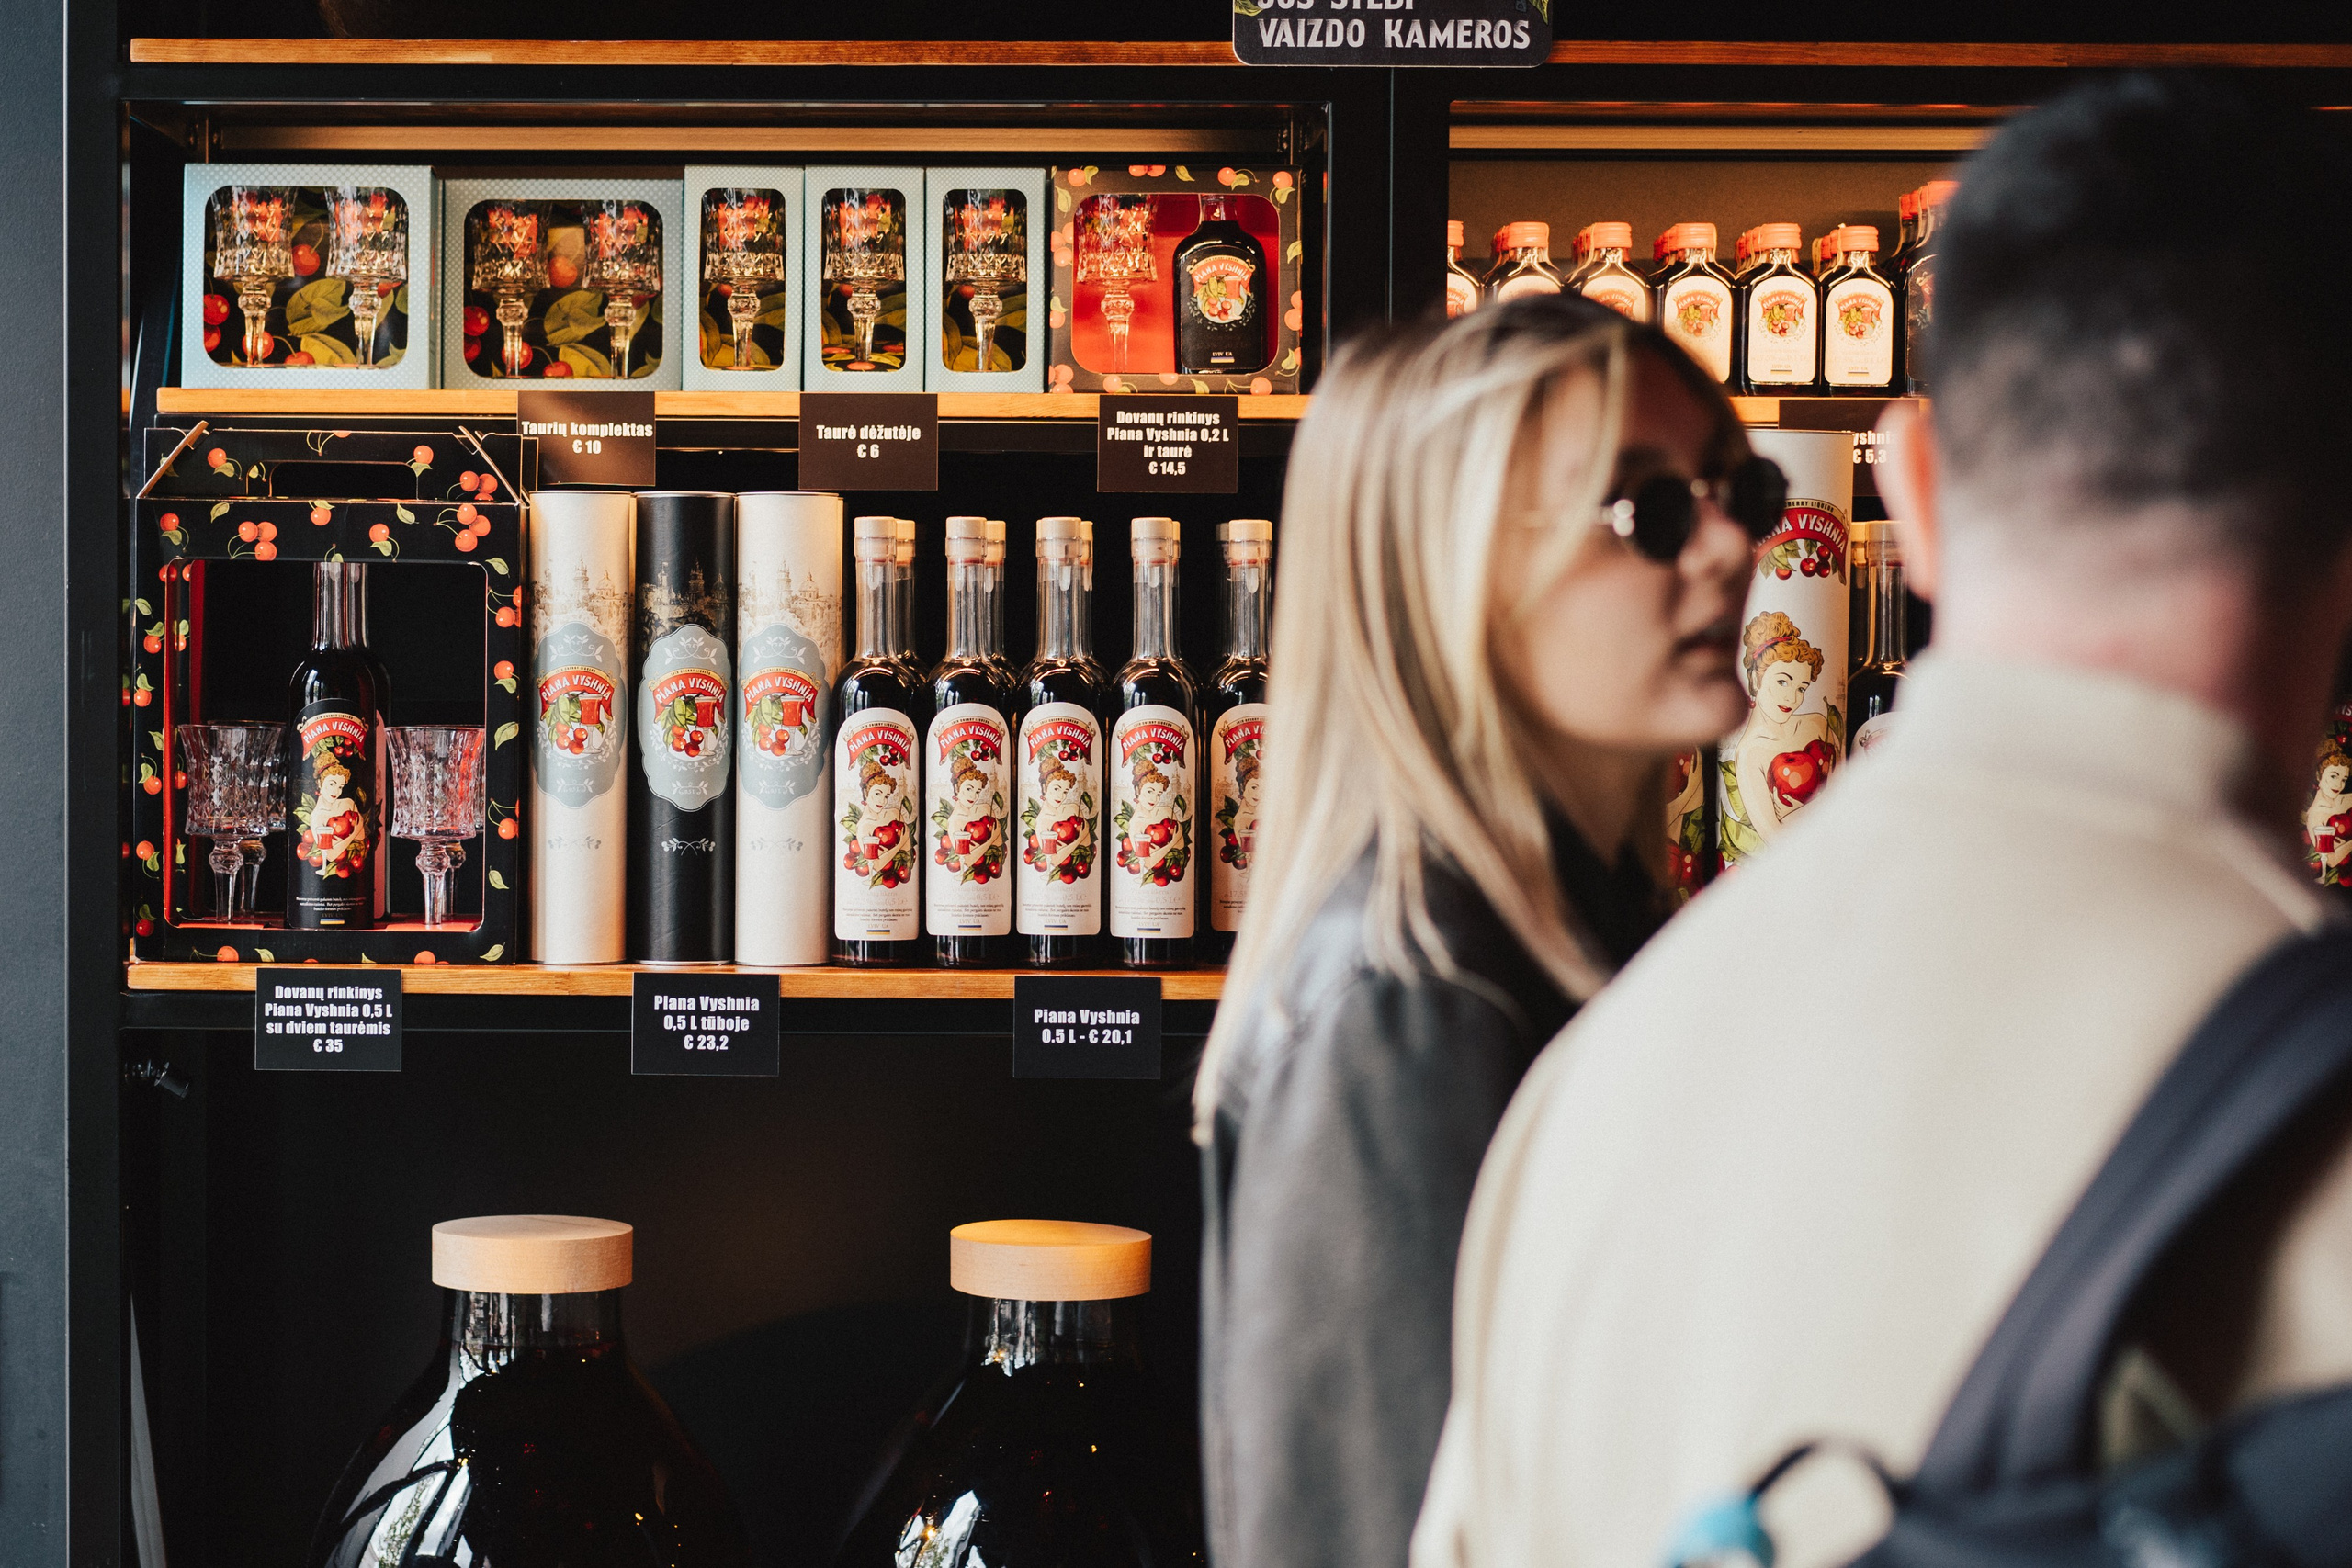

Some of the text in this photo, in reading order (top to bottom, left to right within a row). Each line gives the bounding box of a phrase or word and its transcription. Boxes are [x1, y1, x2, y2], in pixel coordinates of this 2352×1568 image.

[1257, 18, 1531, 49] VAIZDO KAMEROS
[1116, 411, 1220, 426] Dovanų rinkinys
[521, 421, 653, 437] Taurių komplektas
[816, 424, 922, 442] Taurė dėžutėje
[1106, 427, 1230, 443] Piana Vyshnia 0,2 L
[1841, 430, 1896, 446] yshni
[572, 439, 602, 455] € 10
[856, 444, 880, 459] € 6
[1157, 445, 1193, 458] taurė
[1852, 448, 1862, 464] €
[1148, 461, 1187, 476] € 14,5
[1797, 513, 1847, 553] VYSHNIA
[541, 674, 612, 701] PIANA VYSHNIA
[655, 677, 725, 704] PIANA VYSHNIA
[745, 676, 815, 703] PIANA VYSHNIA
[303, 721, 365, 746] PIANA VYSHNIA
[849, 729, 910, 753] PIANA VYSHNIA
[939, 725, 1001, 749] PIANA VYSHNIA
[1029, 725, 1091, 749] PIANA VYSHNIA
[1122, 728, 1184, 751] PIANA VYSHNIA
[1225, 727, 1251, 748] PIANA
[274, 985, 383, 1001] Dovanų rinkinys
[265, 1002, 393, 1019] Piana Vyshnia 0,5 L
[653, 995, 760, 1012] Piana Vyshnia
[663, 1014, 750, 1032] 0,5 L tūboje
[1034, 1009, 1140, 1026] Piana Vyshnia
[266, 1021, 391, 1035] su dviem taurėmis
[1041, 1028, 1065, 1043] 0.5
[1069, 1029, 1077, 1043] L
[1088, 1029, 1099, 1044] €
[1102, 1029, 1132, 1045] 20,1
[312, 1038, 344, 1053] € 35
[684, 1034, 729, 1052] € 23,2
